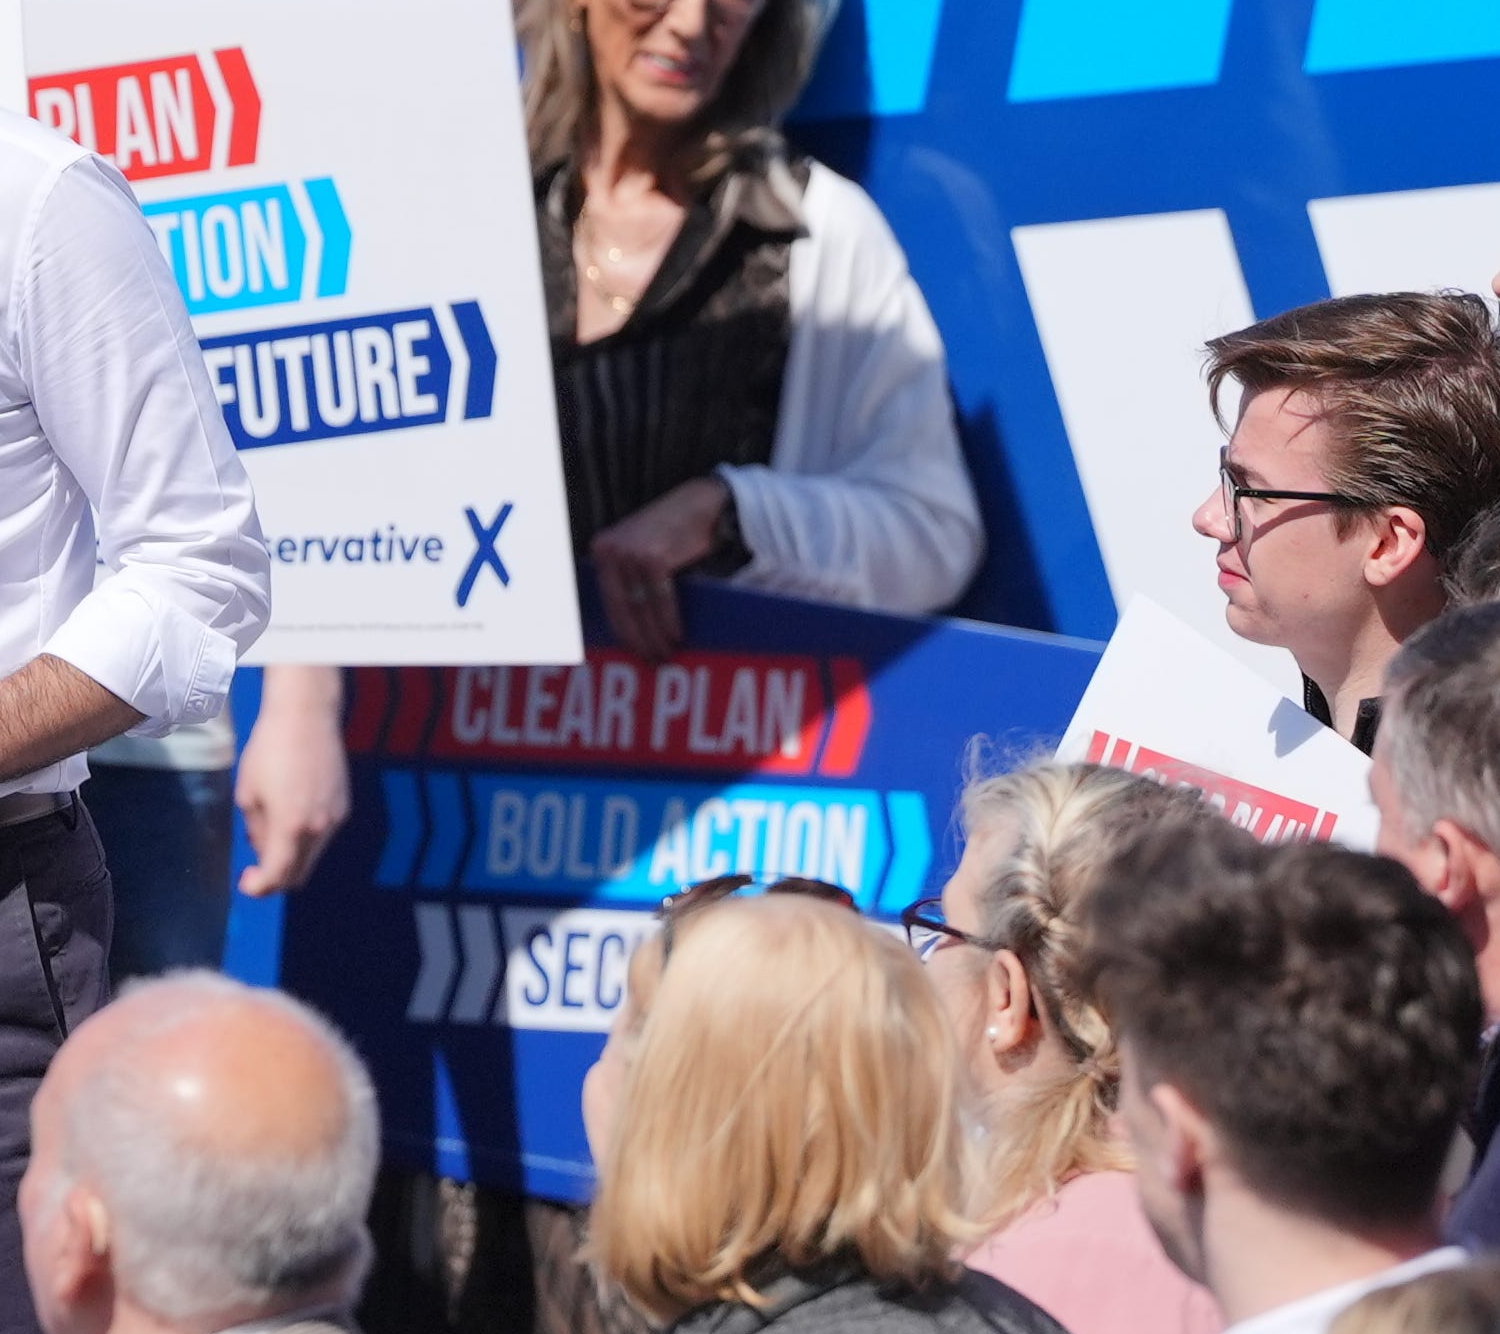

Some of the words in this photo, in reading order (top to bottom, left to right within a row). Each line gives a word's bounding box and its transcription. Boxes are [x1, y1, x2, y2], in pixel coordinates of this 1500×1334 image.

[33, 68, 199, 167] PLAN
[153, 195, 290, 301] TION
[203, 319, 439, 440] FUTURE
[267, 523, 444, 565] ervative
[452, 663, 640, 753] CLEAR
[652, 667, 802, 761] PLAN
[486, 788, 635, 879] BOLD
[652, 792, 867, 890] ACTION
[522, 924, 628, 1010] SEC
